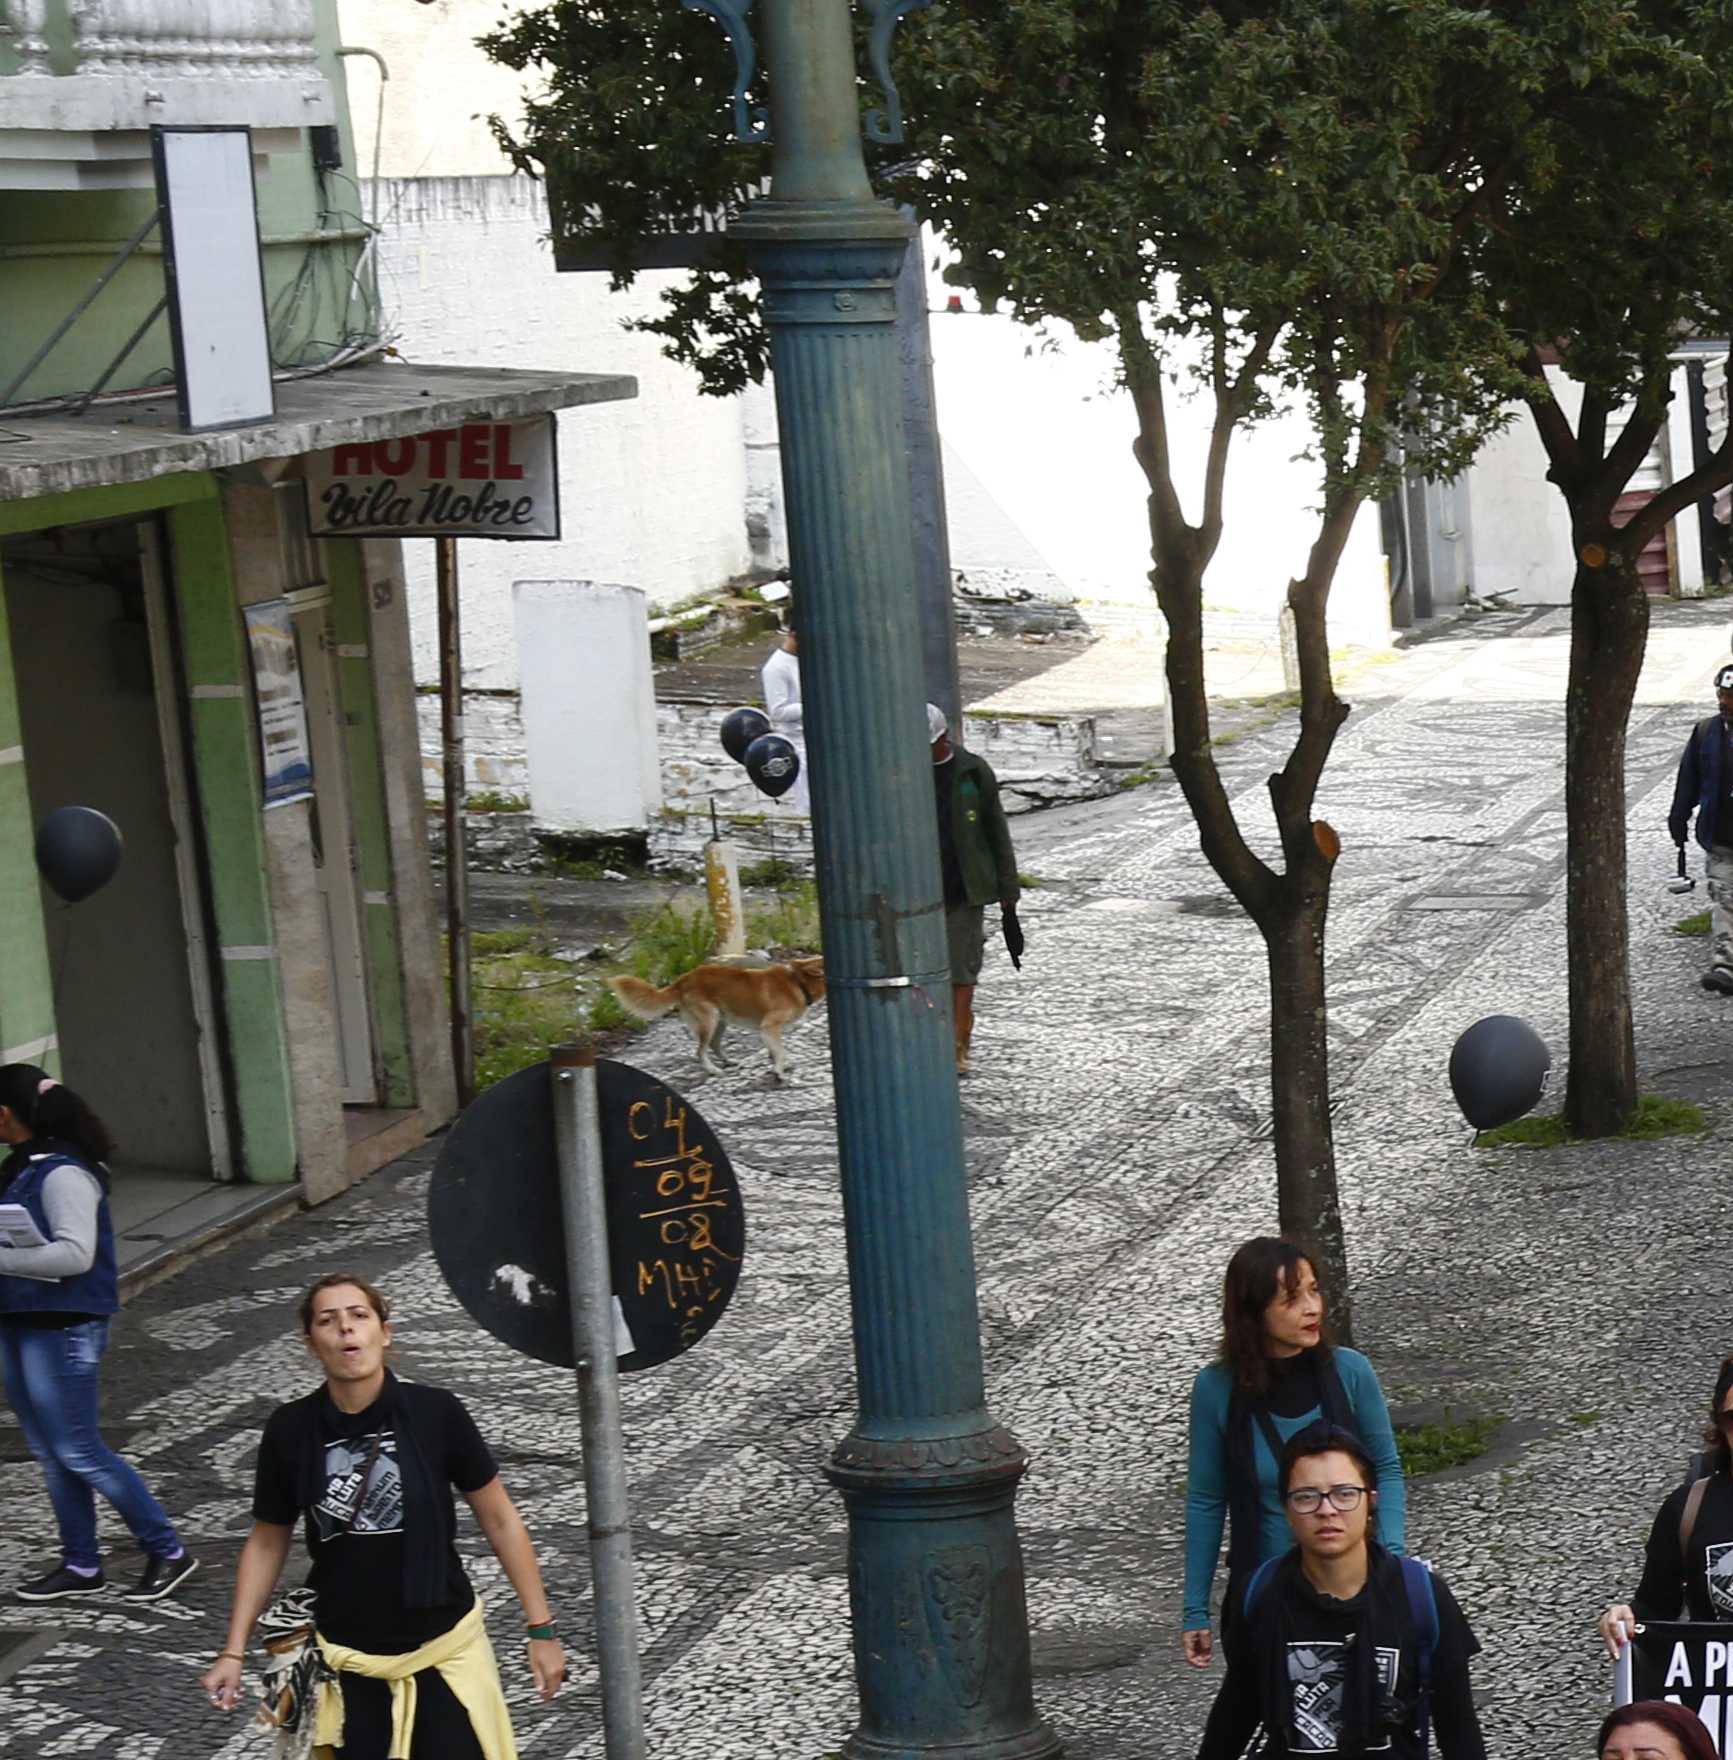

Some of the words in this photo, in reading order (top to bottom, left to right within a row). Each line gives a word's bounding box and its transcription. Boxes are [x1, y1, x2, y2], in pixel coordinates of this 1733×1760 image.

[332, 423, 524, 480] HOTEL
[321, 478, 413, 527] Vila
[417, 480, 535, 526] Nobre
[326, 1477, 345, 1496] NA
[336, 1472, 364, 1502] LUTA
[1663, 1641, 1693, 1688] A
[1298, 1680, 1331, 1711] LUTA
